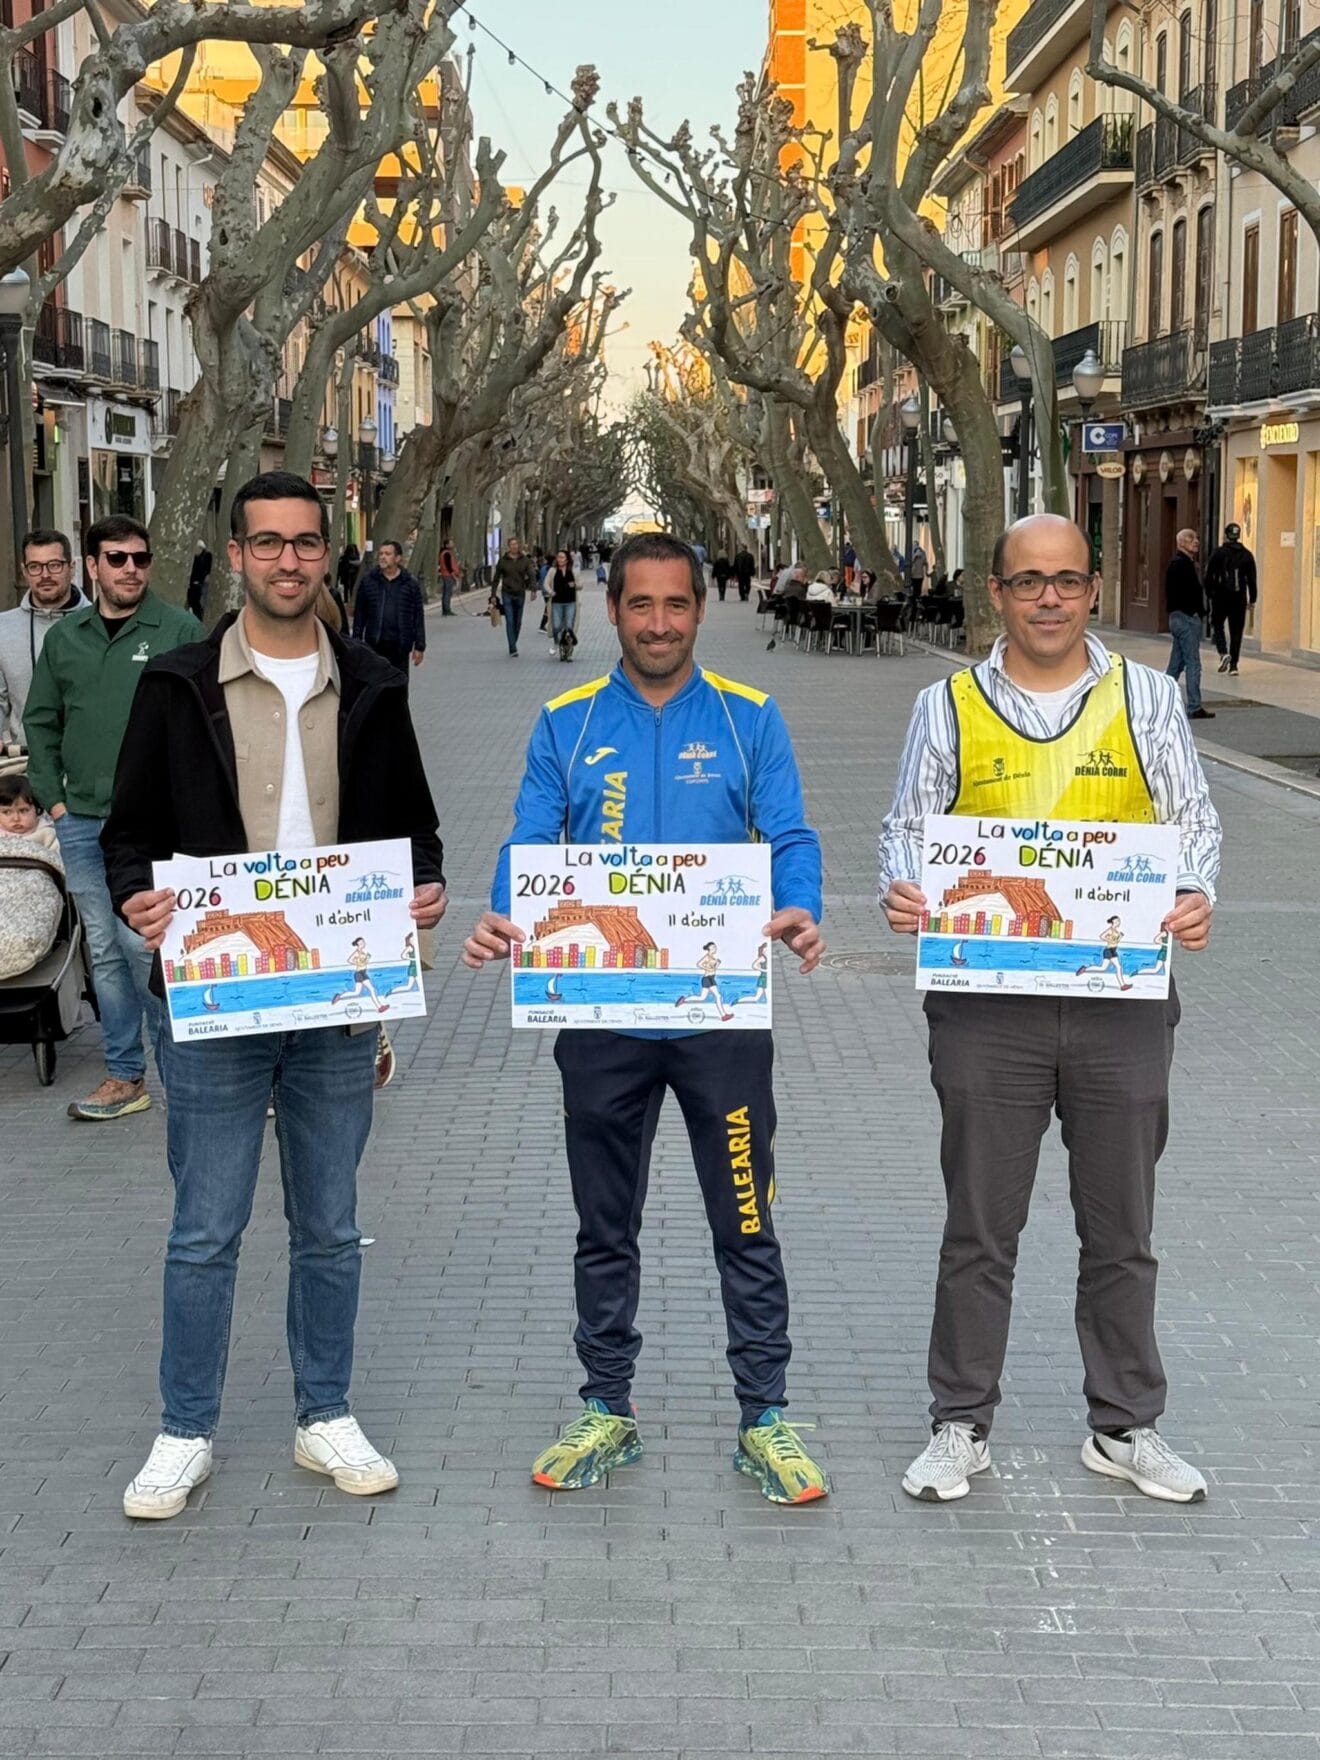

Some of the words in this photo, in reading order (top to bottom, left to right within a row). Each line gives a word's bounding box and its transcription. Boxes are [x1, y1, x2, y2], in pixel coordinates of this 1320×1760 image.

[1102, 767, 1128, 777] CORRE
[600, 771, 629, 844] ARIA
[978, 821, 1004, 839] La
[1011, 821, 1063, 842] volta
[1066, 831, 1078, 842] a
[1082, 830, 1116, 847] peu
[209, 860, 238, 878] La
[243, 853, 296, 875] volta
[300, 857, 312, 868] a
[316, 852, 350, 873] peu
[565, 848, 592, 867] La
[599, 846, 653, 867] volta
[655, 855, 668, 866] a
[672, 853, 706, 872] peu
[928, 842, 987, 865] 2026
[1018, 842, 1094, 869] DÉNIA
[170, 886, 222, 912] 026
[254, 873, 331, 901] DÉNIA
[517, 873, 575, 897] 2026
[608, 868, 685, 894] DÉNIA
